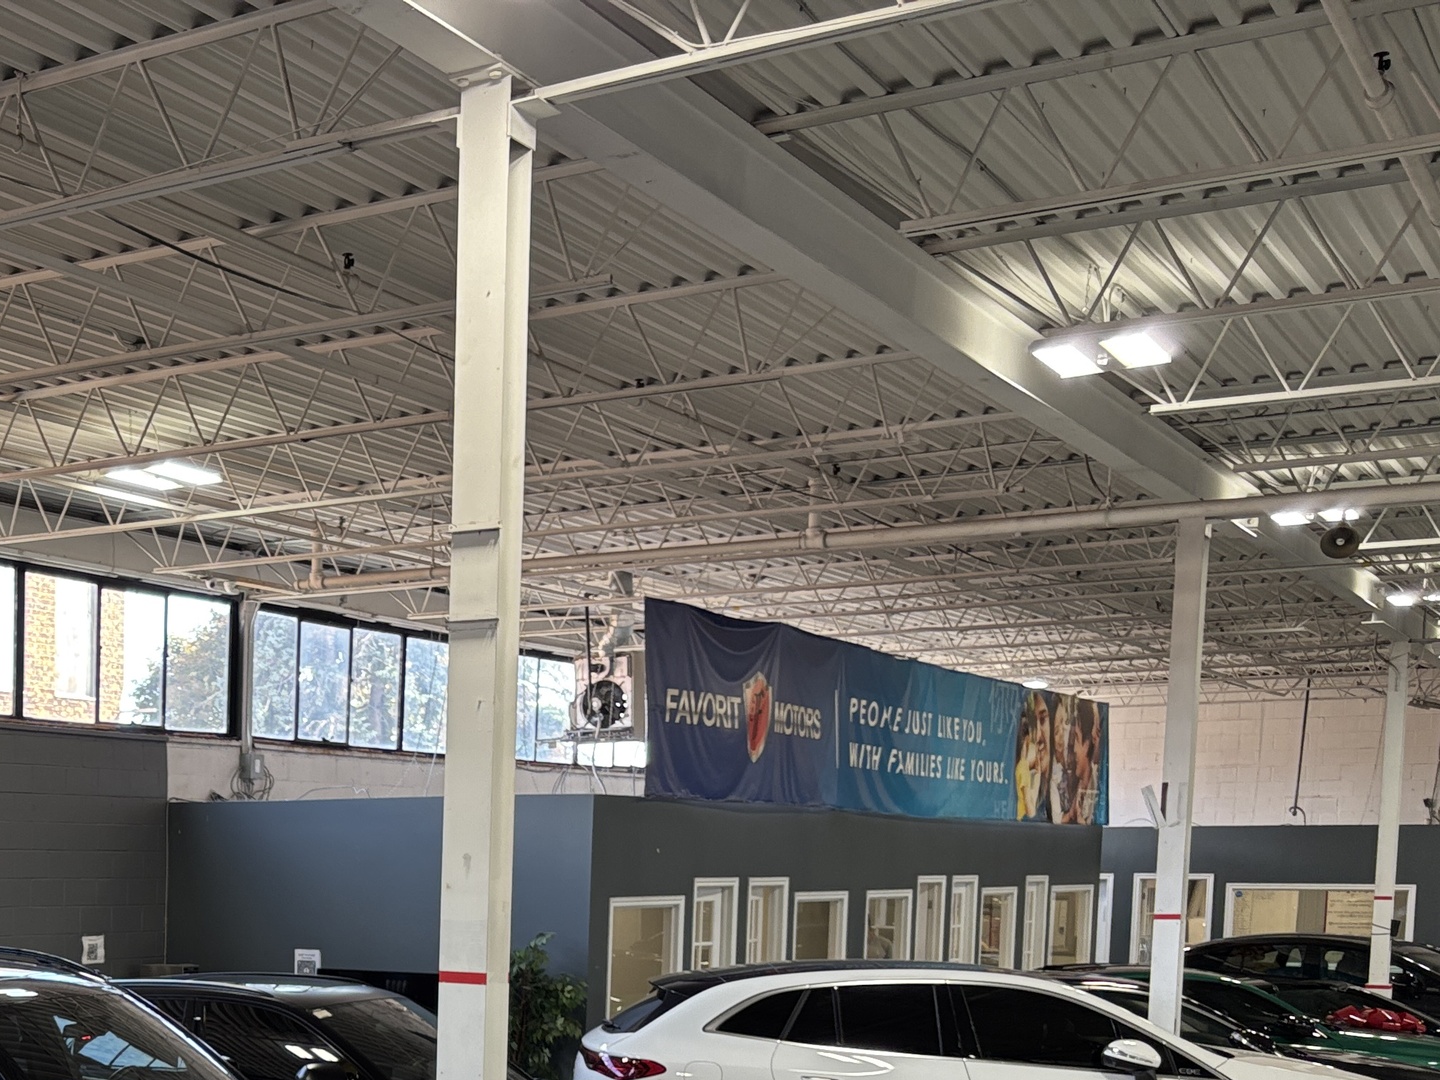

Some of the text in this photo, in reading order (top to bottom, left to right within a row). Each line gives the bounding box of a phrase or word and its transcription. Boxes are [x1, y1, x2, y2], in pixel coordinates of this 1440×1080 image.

[664, 687, 822, 740] FAVORIT MOTORS
[904, 709, 934, 736] JUST
[937, 714, 960, 740] LIKE
[849, 741, 882, 771] WITH
[887, 748, 943, 779] FAMILIES
[946, 756, 966, 781] LIKE
